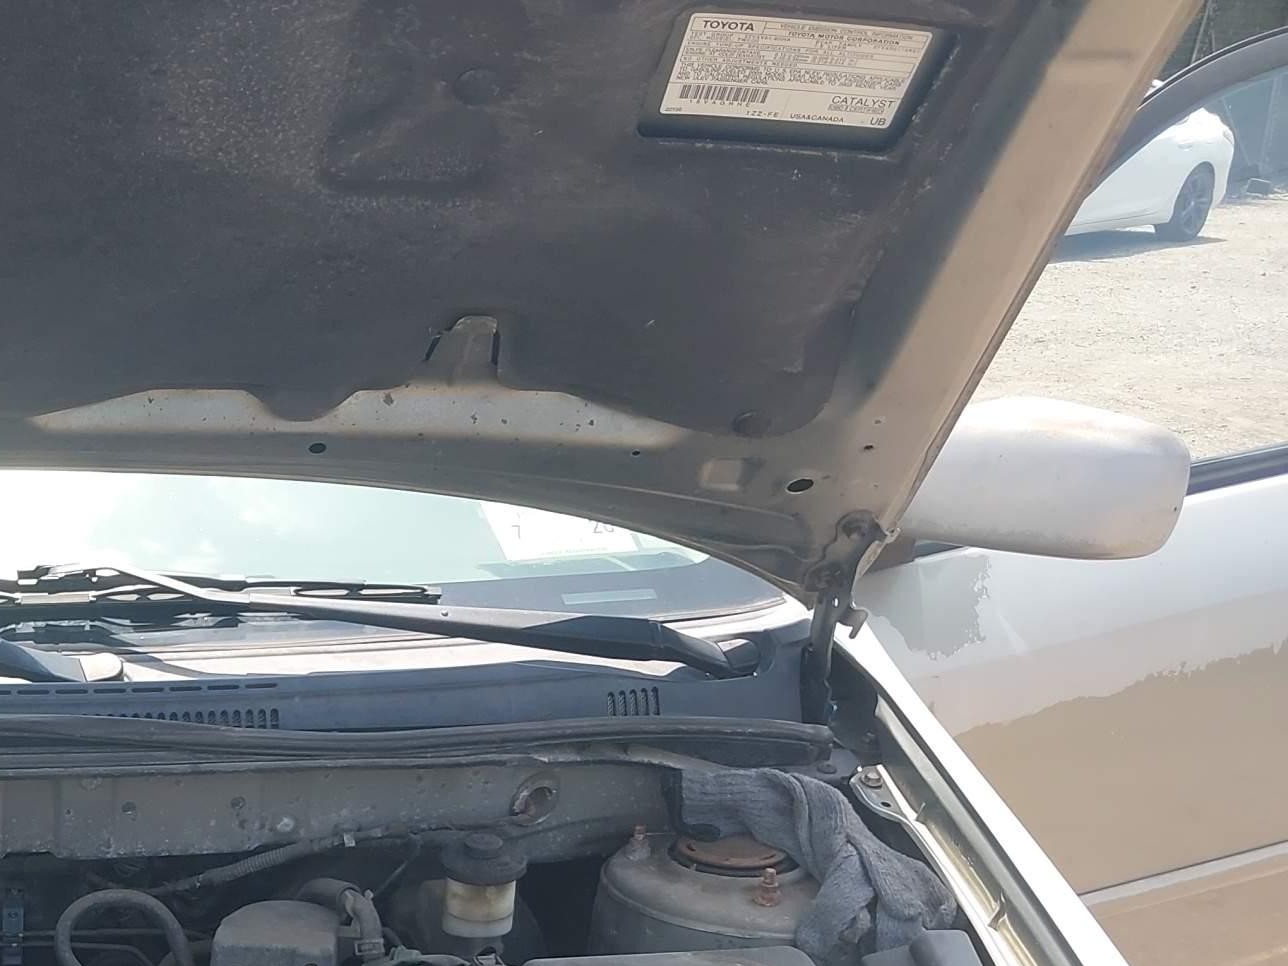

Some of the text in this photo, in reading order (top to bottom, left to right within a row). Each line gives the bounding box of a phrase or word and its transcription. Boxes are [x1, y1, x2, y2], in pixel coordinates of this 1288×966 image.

[703, 19, 755, 32] TOYOTA
[788, 31, 815, 39] TOYOTA
[817, 33, 844, 41] MOTOR
[846, 36, 900, 46] CORPORATION
[831, 95, 897, 109] CATALYST
[790, 113, 844, 123] USA&CANADA
[870, 117, 887, 126] UB
